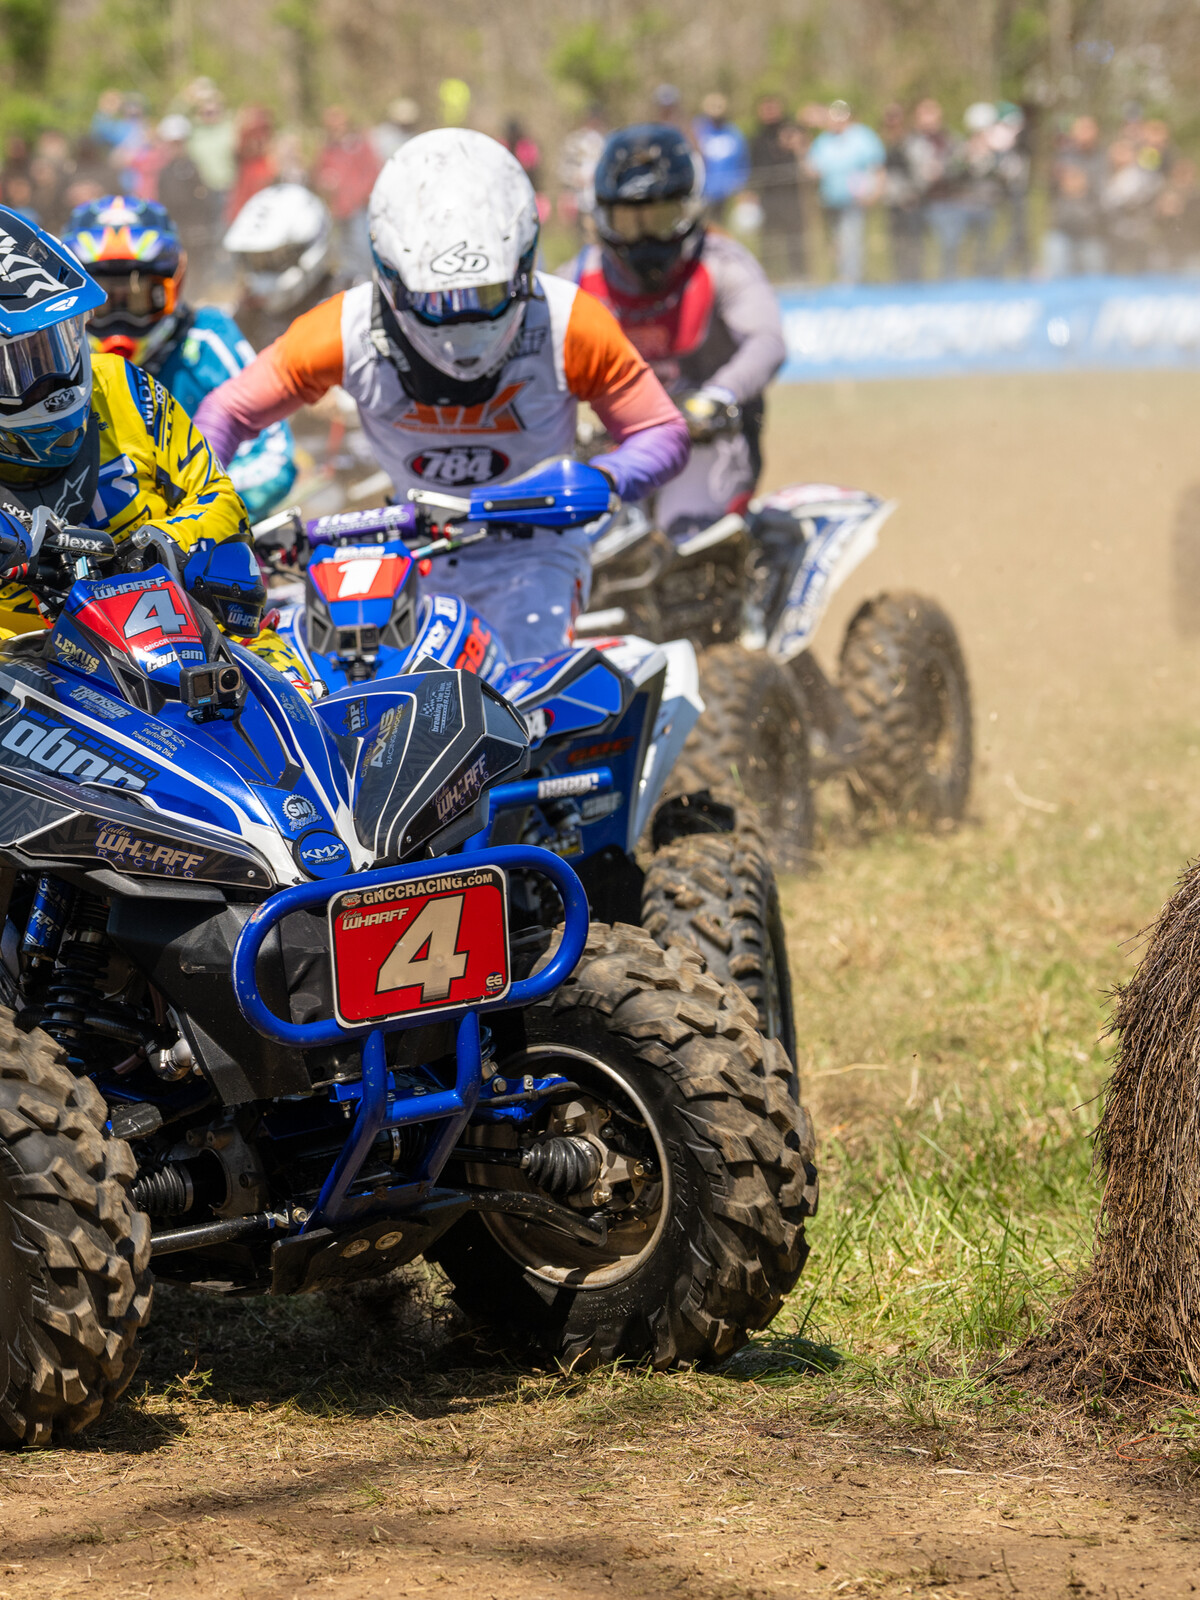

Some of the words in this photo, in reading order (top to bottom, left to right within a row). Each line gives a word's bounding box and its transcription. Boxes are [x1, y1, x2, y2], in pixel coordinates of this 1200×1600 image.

[431, 240, 490, 275] 6D
[421, 451, 494, 484] 784
[56, 533, 104, 552] flexx
[93, 575, 166, 600] WHARFF
[338, 558, 383, 599] 1
[123, 588, 188, 640] 4
[54, 632, 100, 670] LEMUS
[146, 649, 204, 673] can-am
[131, 731, 163, 751] Powersports
[141, 728, 178, 751] Performance
[370, 707, 396, 768] AXIS
[287, 801, 312, 817] SM
[97, 820, 132, 837] Kaden
[95, 832, 205, 871] WHARFF
[96, 849, 196, 879] RACING
[362, 872, 494, 905] GNCCRACING.COM
[341, 907, 410, 931] WHARFF
[374, 892, 470, 1004] 4
